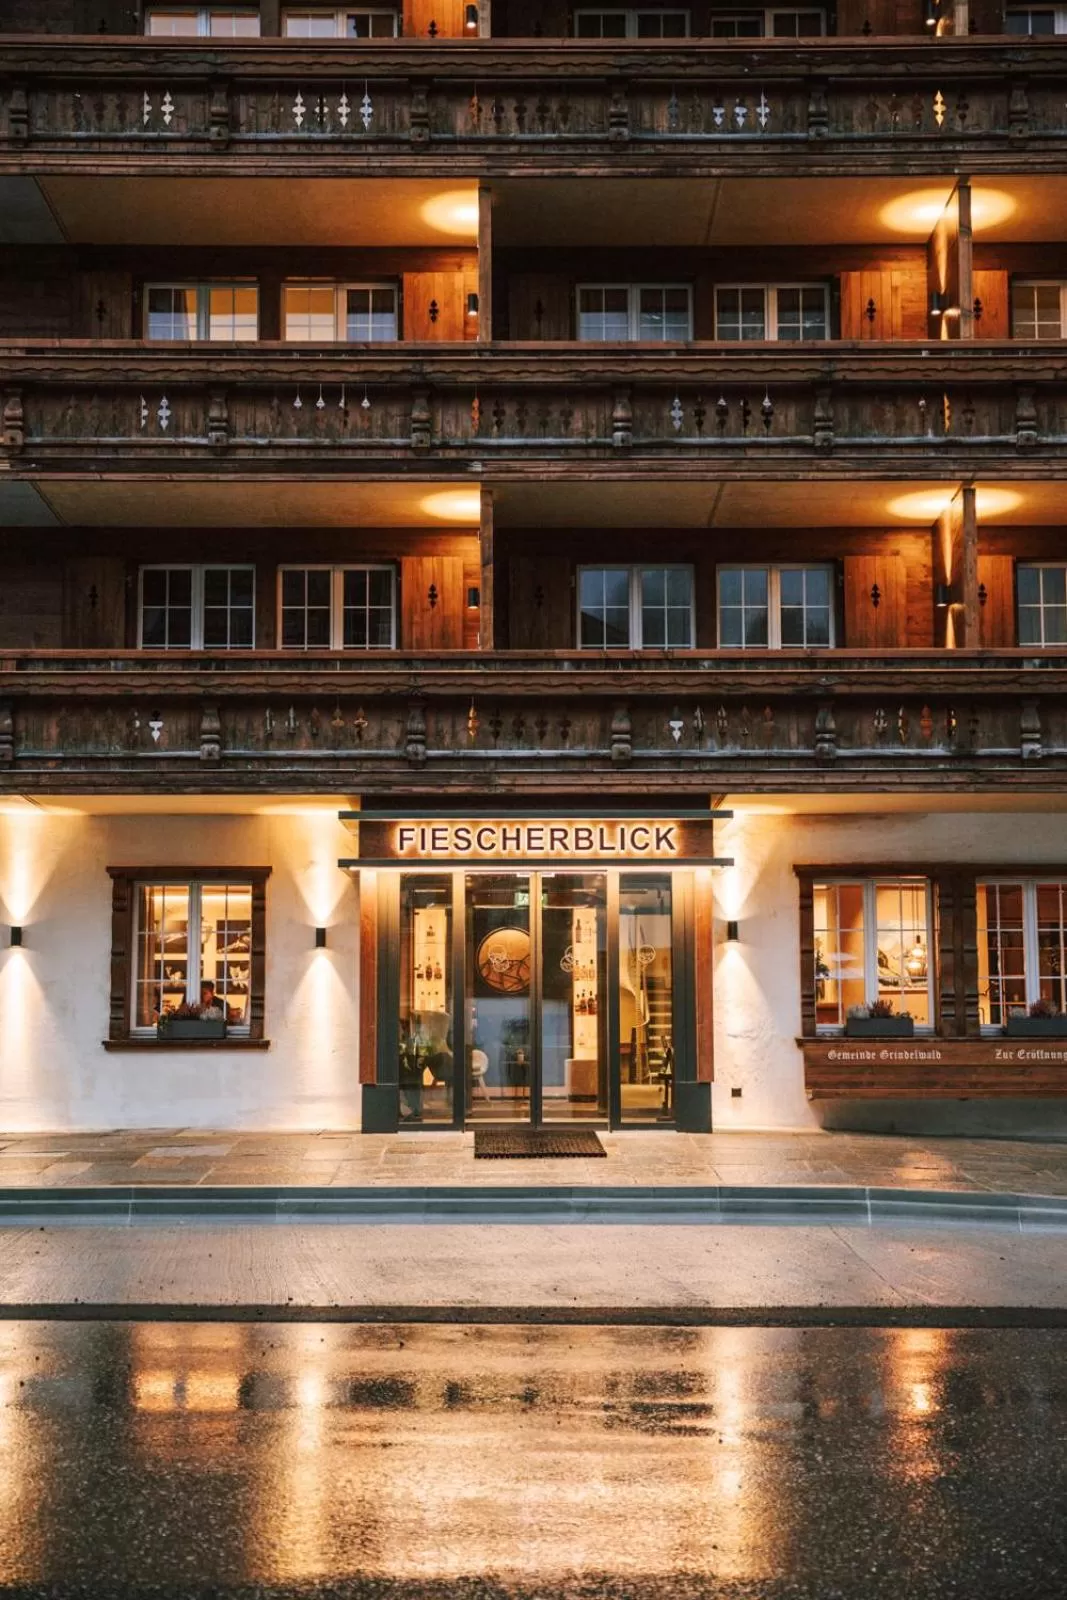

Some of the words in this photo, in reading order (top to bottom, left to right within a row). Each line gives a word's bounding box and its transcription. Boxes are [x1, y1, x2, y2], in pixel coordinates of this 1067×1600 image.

[398, 826, 677, 851] FIESCHERBLICK
[827, 1049, 877, 1061] Gemeinde
[879, 1049, 942, 1061] Grindelwald
[994, 1048, 1014, 1060] Zur
